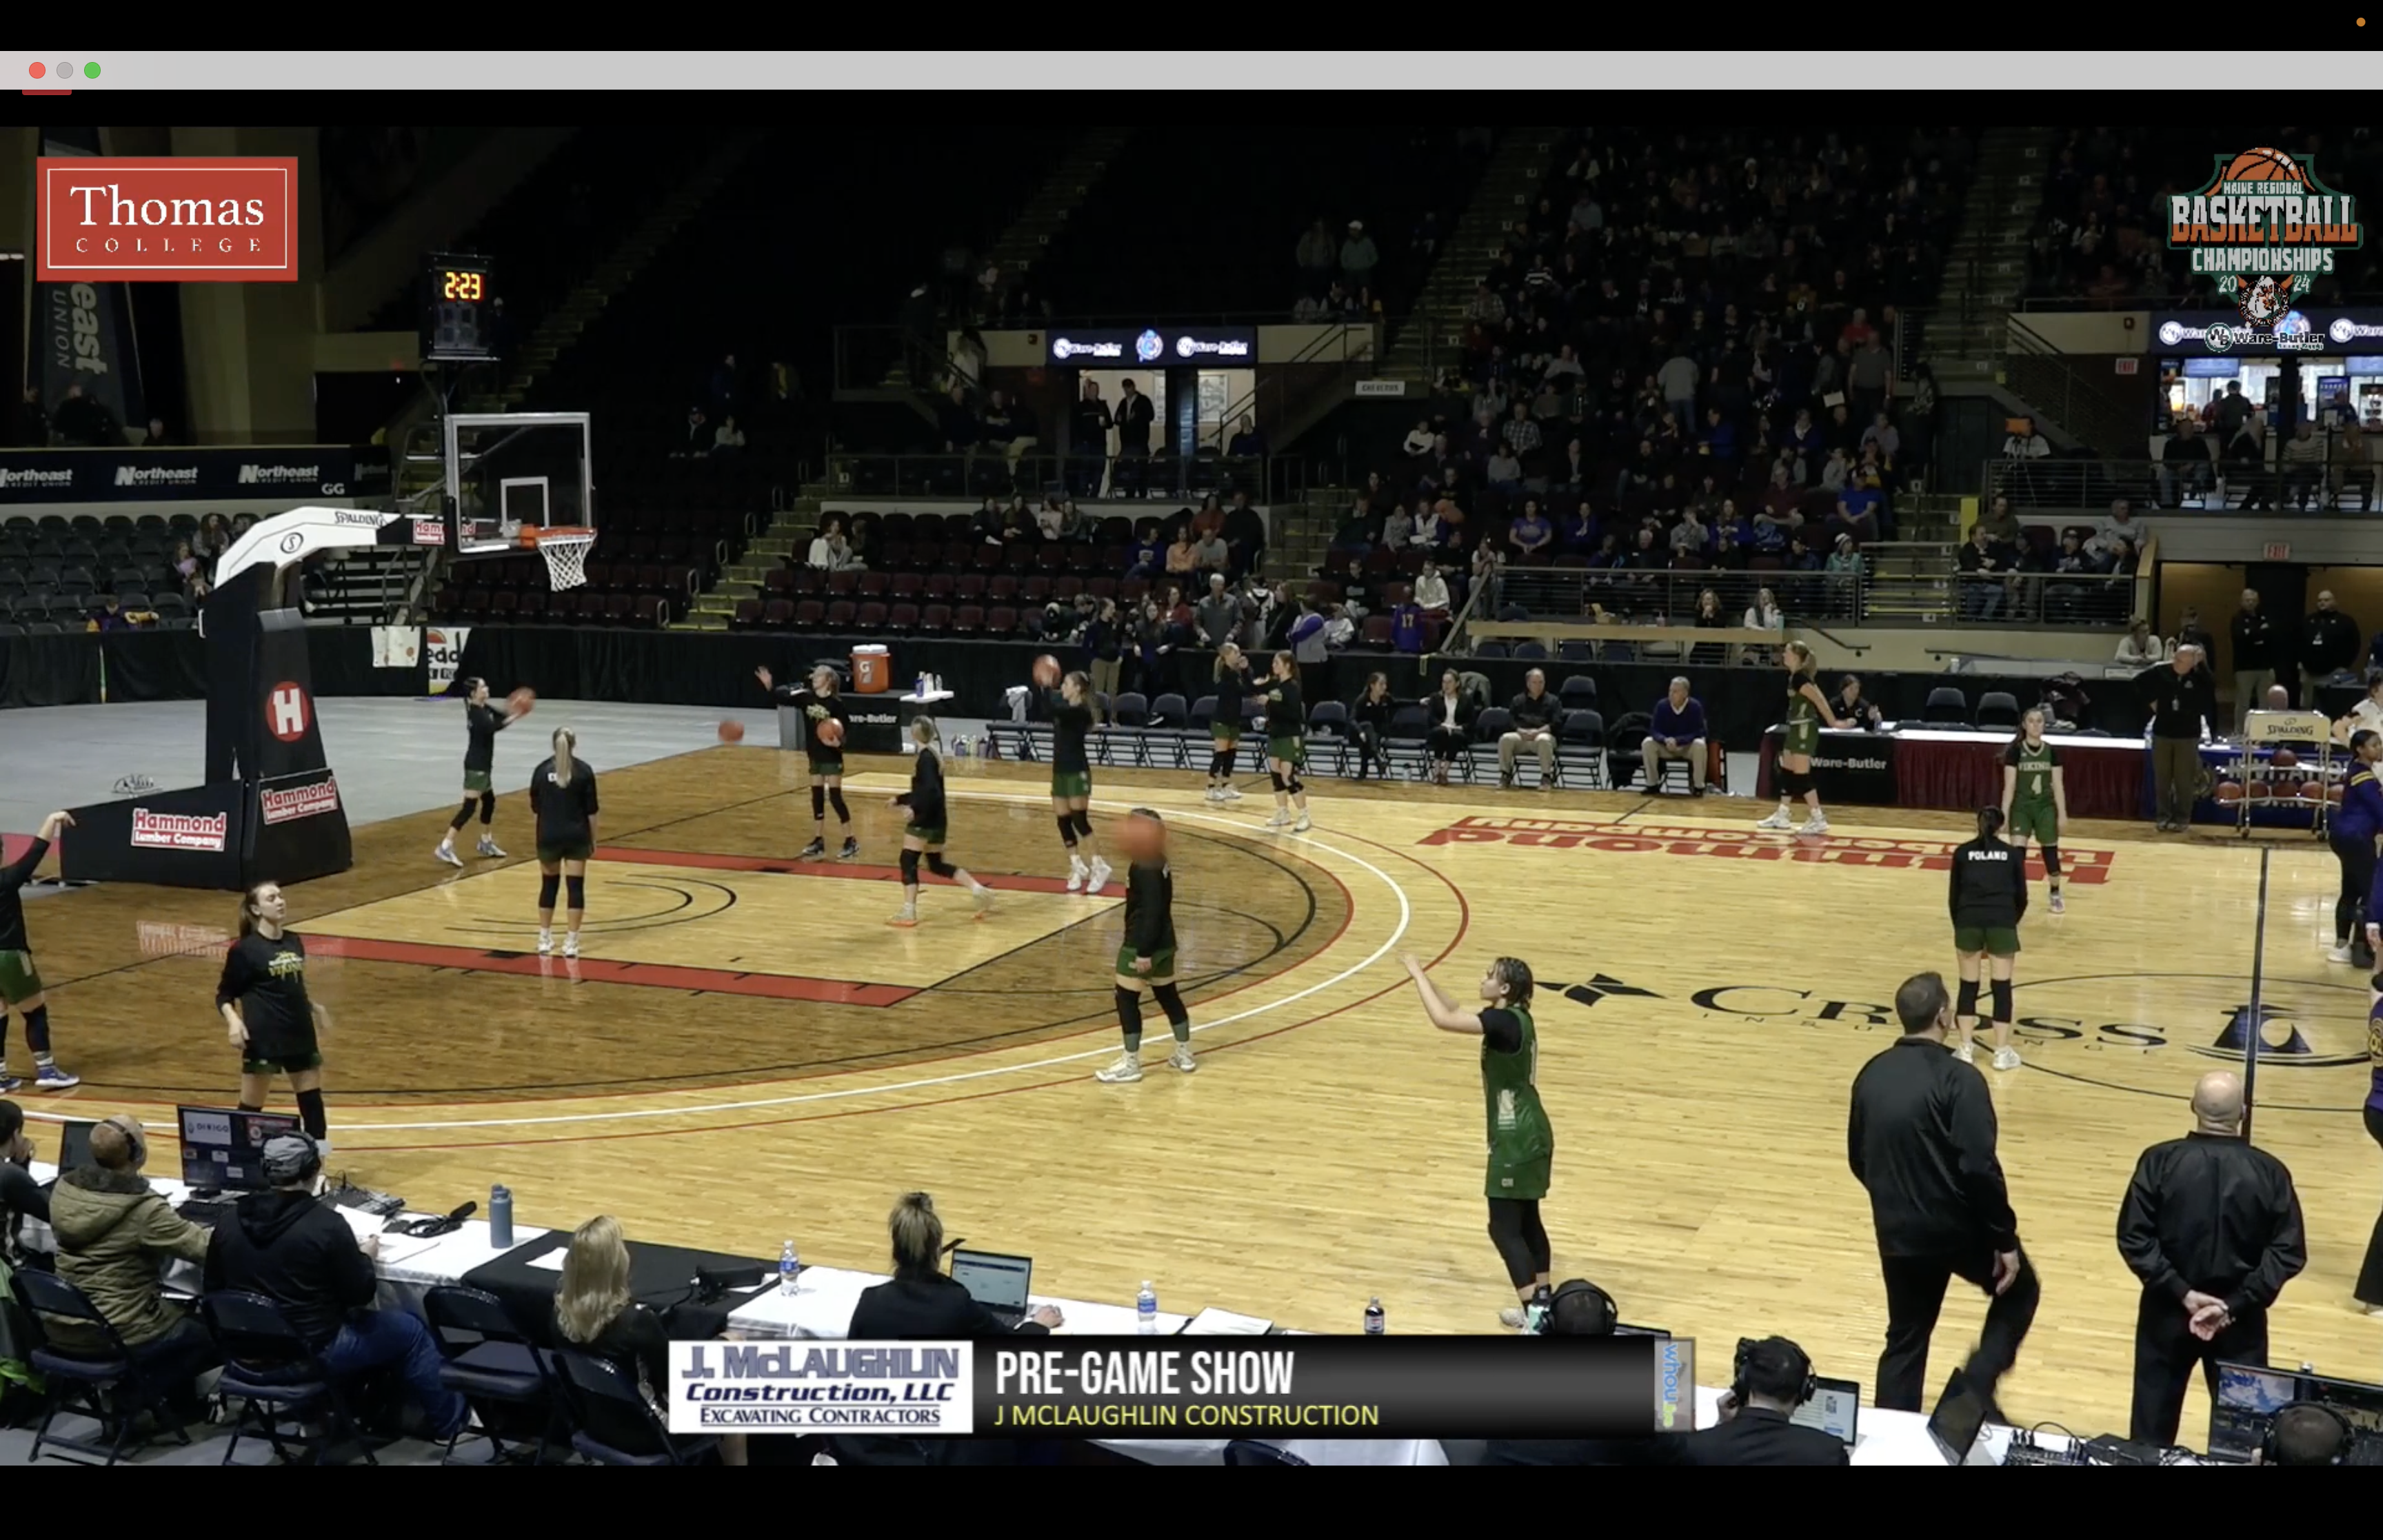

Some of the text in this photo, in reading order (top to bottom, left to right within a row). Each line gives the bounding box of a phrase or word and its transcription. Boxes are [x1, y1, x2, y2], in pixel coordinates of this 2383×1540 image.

[445, 272, 481, 299] 2:23
[52, 290, 71, 369] UNION
[70, 282, 108, 374] east
[114, 466, 199, 485] Northeast
[238, 465, 320, 483] Northeast
[321, 483, 345, 495] GG
[272, 688, 304, 735] H
[849, 713, 897, 724] re-Butler
[2266, 724, 2314, 736] SPALDING
[1810, 757, 1887, 770] Ware-Butler
[262, 776, 336, 809] Hammond
[2031, 773, 2042, 796] 4
[133, 809, 227, 833] Hammond
[134, 832, 222, 849] Lumber Company
[1968, 851, 2009, 861] POLAND
[1691, 985, 2167, 1046] CRSS
